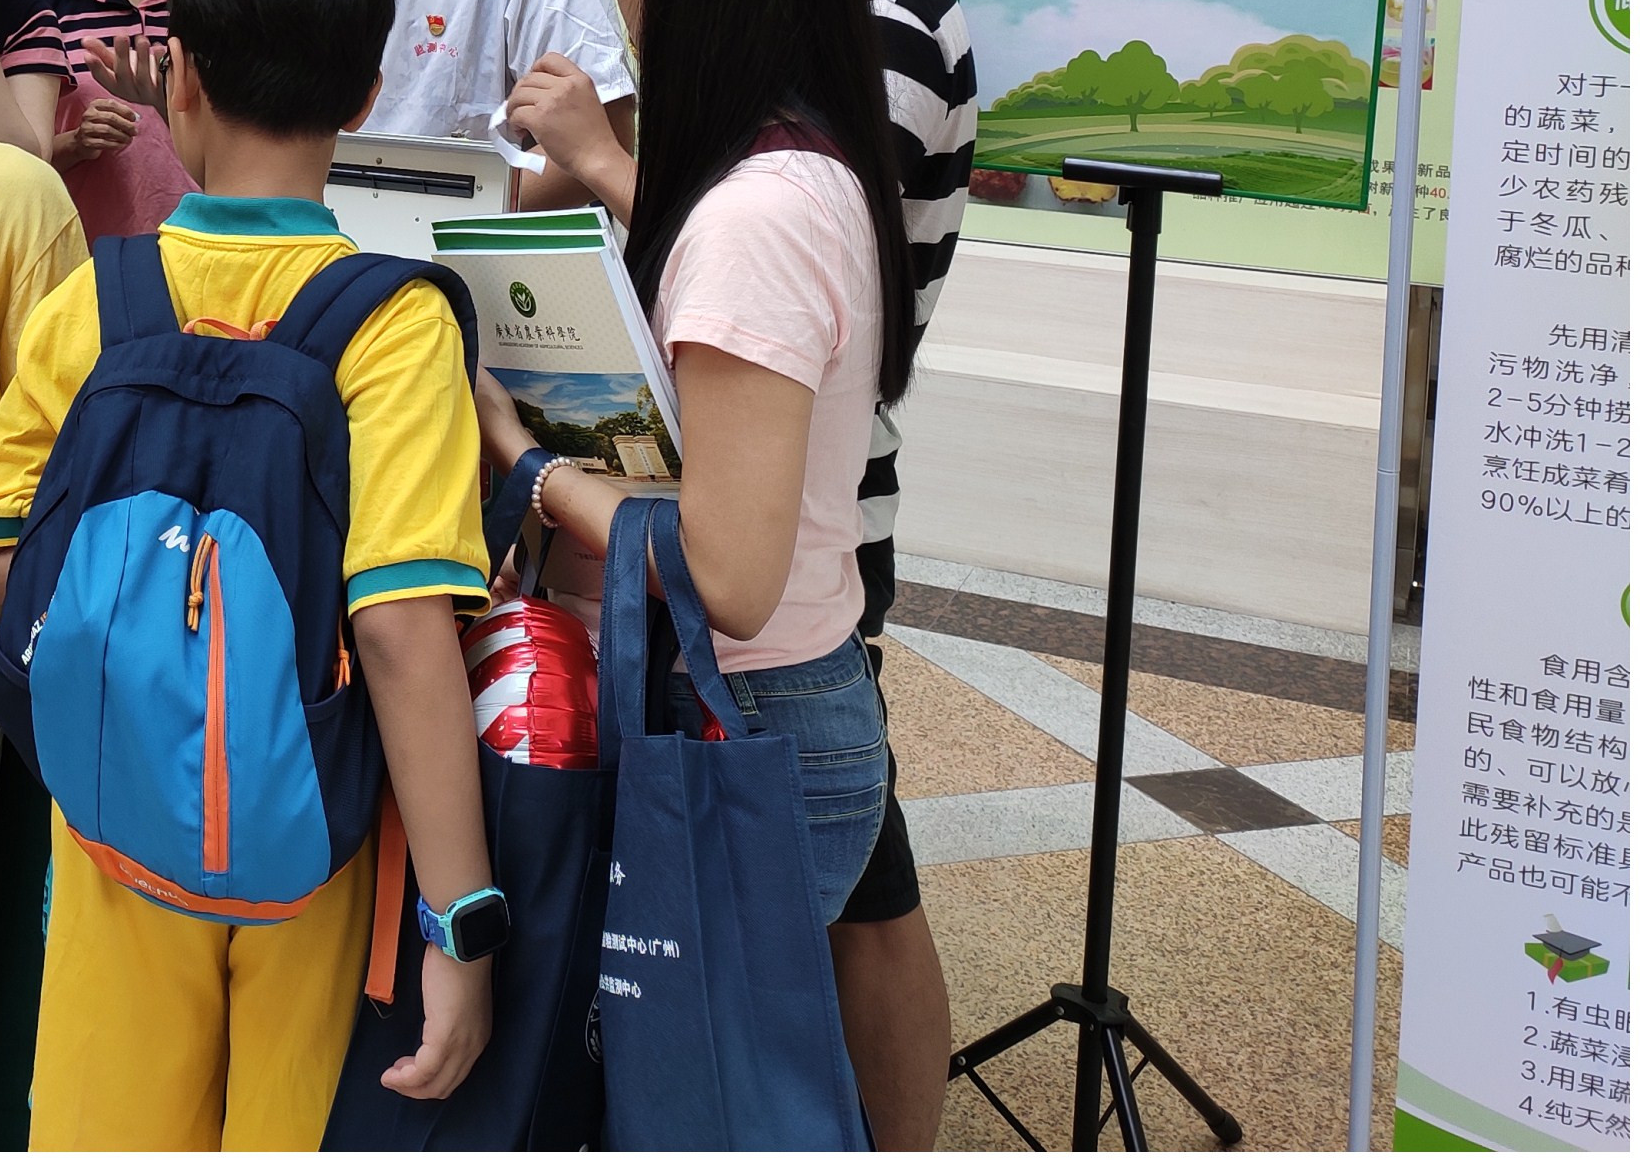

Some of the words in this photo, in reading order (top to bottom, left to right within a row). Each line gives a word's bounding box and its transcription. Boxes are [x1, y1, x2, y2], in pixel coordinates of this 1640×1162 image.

[1504, 104, 1615, 134] 的蔬菜，
[1500, 140, 1630, 171] 定时间的
[1498, 174, 1628, 206] 少农药残
[1496, 210, 1609, 240] 于冬瓜、
[1481, 454, 1630, 495] 烹饪成菜肴
[1467, 675, 1627, 726] 性和食用量
[1466, 711, 1629, 761] 民食物结构
[1464, 745, 1630, 796] 的、可以放
